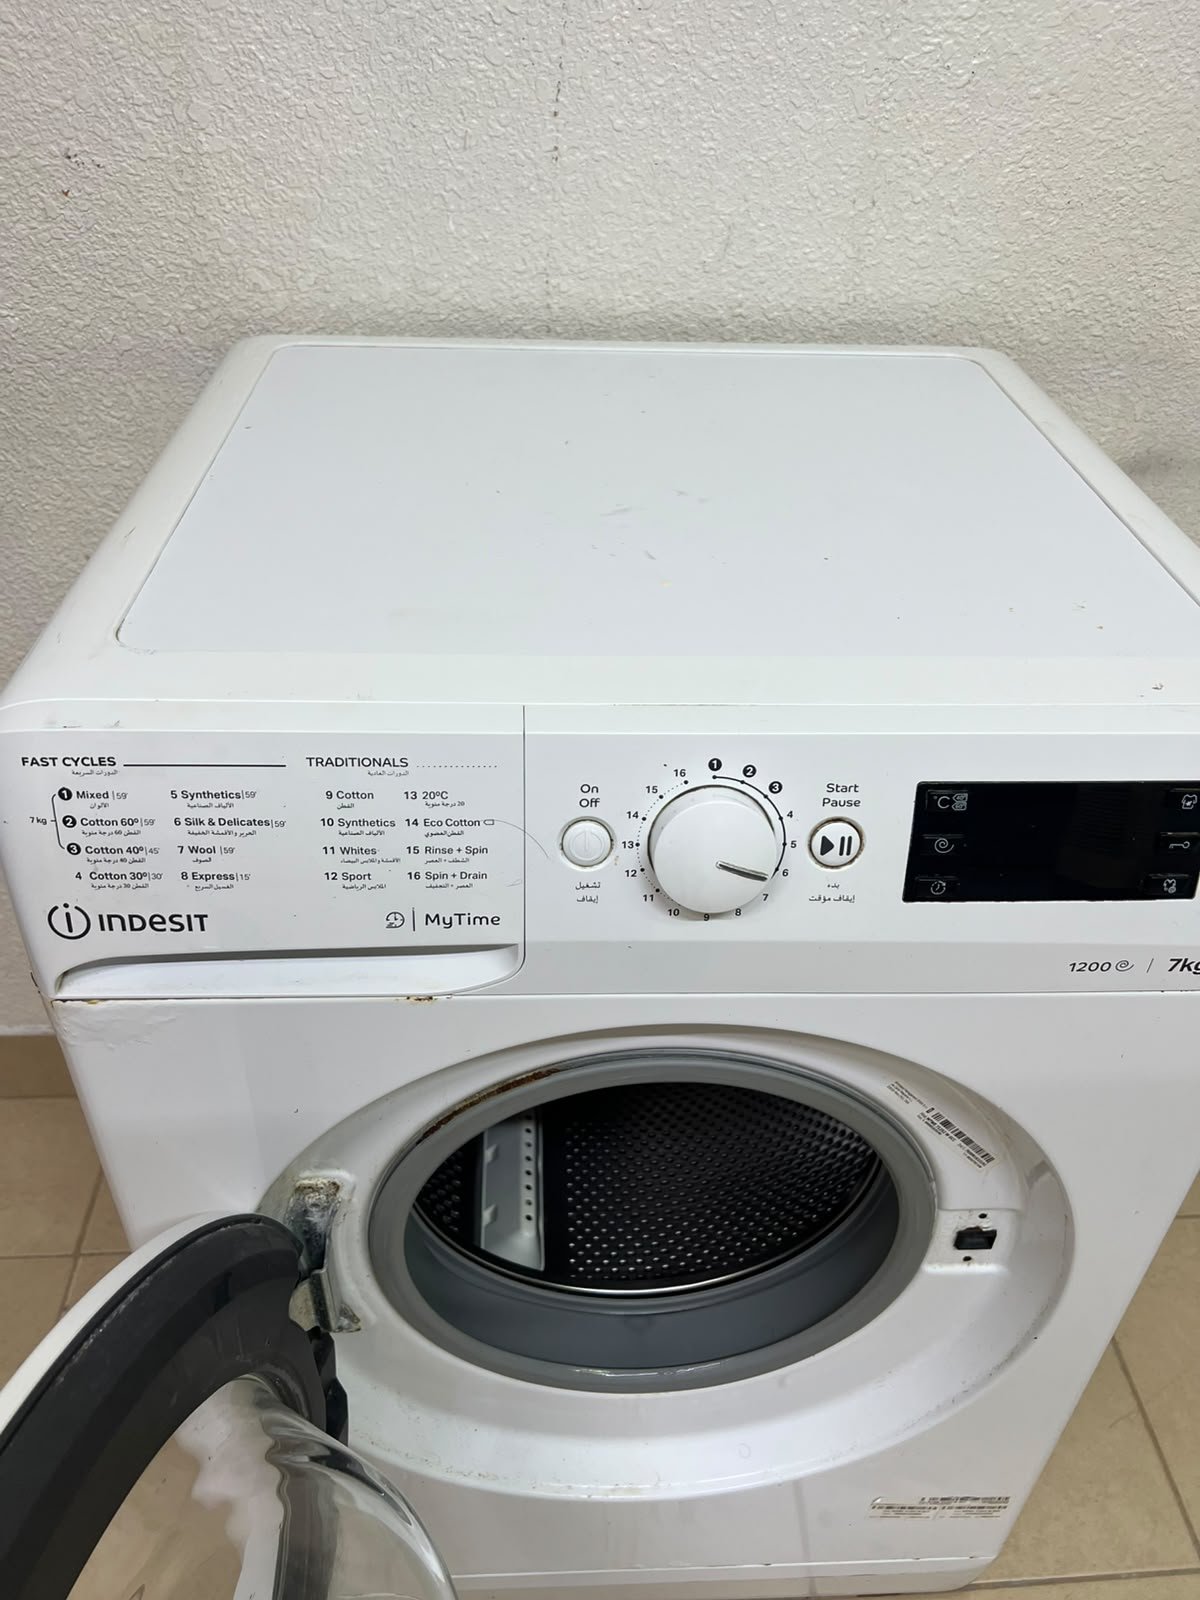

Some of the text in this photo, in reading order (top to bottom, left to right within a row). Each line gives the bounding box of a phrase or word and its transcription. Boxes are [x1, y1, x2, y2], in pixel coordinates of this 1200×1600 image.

[21, 757, 117, 767] FAST CYCLES
[306, 757, 409, 768] TRADITIONALS
[674, 769, 686, 777] 16
[580, 784, 599, 794] On
[646, 786, 658, 794] 15
[826, 783, 859, 793] Start
[76, 791, 109, 799] Mixed
[170, 790, 178, 799] 5
[181, 790, 241, 800] Synthetics
[325, 790, 374, 800] 9 Cotton
[404, 791, 417, 800] 13
[579, 798, 600, 808] Off
[822, 797, 861, 808] Pause
[627, 811, 639, 819] 14
[36, 817, 47, 825] kg
[80, 818, 118, 827] Cotton
[174, 817, 181, 827] 6
[184, 817, 206, 827] Silk
[207, 818, 216, 827] &
[218, 817, 270, 827] Delicates
[321, 818, 396, 829] 10 Synthetics
[405, 818, 481, 827] 14 Eco Cotton
[622, 841, 634, 849] 13
[790, 840, 797, 849] 5
[85, 845, 123, 855] Cotton
[177, 845, 184, 854] 7
[187, 845, 216, 854] Wool
[322, 846, 377, 855] 11 Whites
[406, 846, 420, 855] 15
[424, 846, 454, 855] Rinse
[465, 845, 488, 856] Spin
[75, 872, 82, 880] 4
[89, 871, 127, 880] Cotton
[181, 872, 189, 881] 8
[191, 872, 235, 882] Express
[324, 872, 372, 882] 12 Sport
[407, 872, 421, 880] 16
[425, 871, 449, 881] Spin
[460, 871, 488, 880] Drain
[625, 870, 637, 878] 12
[782, 869, 789, 877] 6
[668, 909, 680, 917] 10
[735, 908, 741, 917] 8
[425, 913, 501, 929] MyTime
[704, 913, 710, 922] 9
[1069, 962, 1112, 972] 1200
